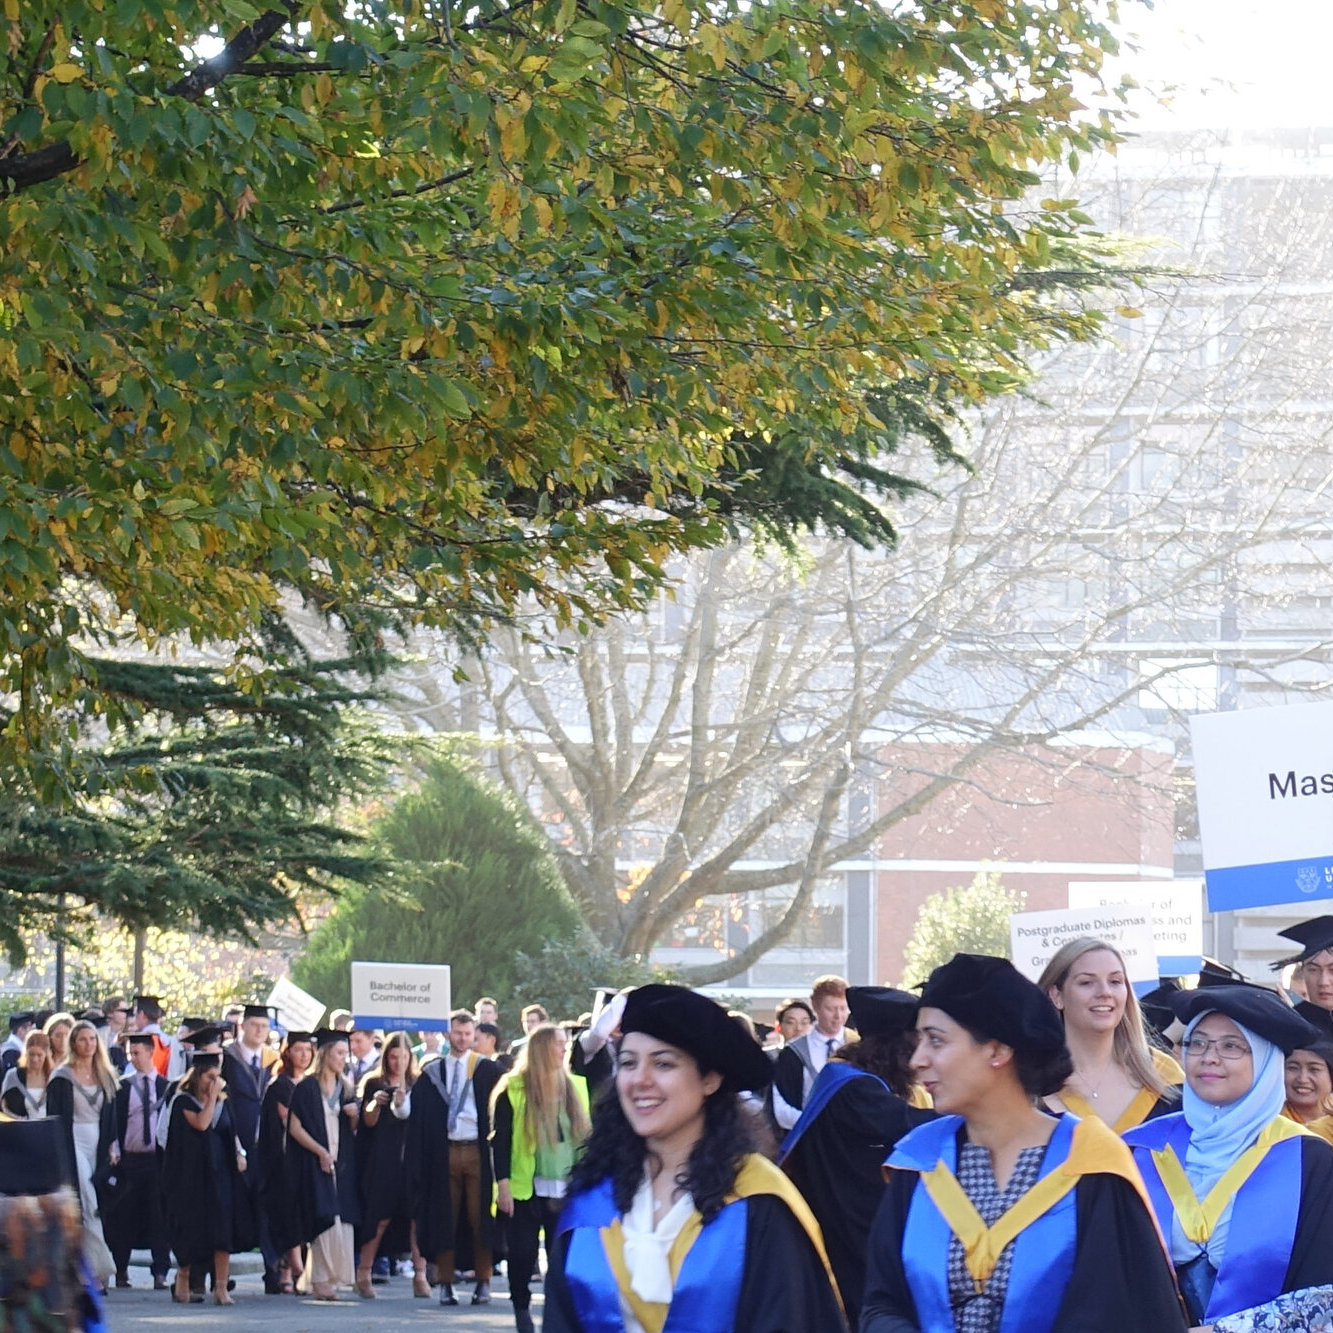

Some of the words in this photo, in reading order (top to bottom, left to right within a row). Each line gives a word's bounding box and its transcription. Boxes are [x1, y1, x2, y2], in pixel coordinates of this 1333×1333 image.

[1160, 898, 1172, 910] of
[1168, 914, 1192, 925] and
[1017, 922, 1091, 938] Postgraduate
[1094, 917, 1146, 931] Diplomas
[1041, 938, 1049, 948] &
[369, 981, 417, 992] Bachelor
[420, 983, 431, 992] of
[370, 992, 431, 1003] Commerce
